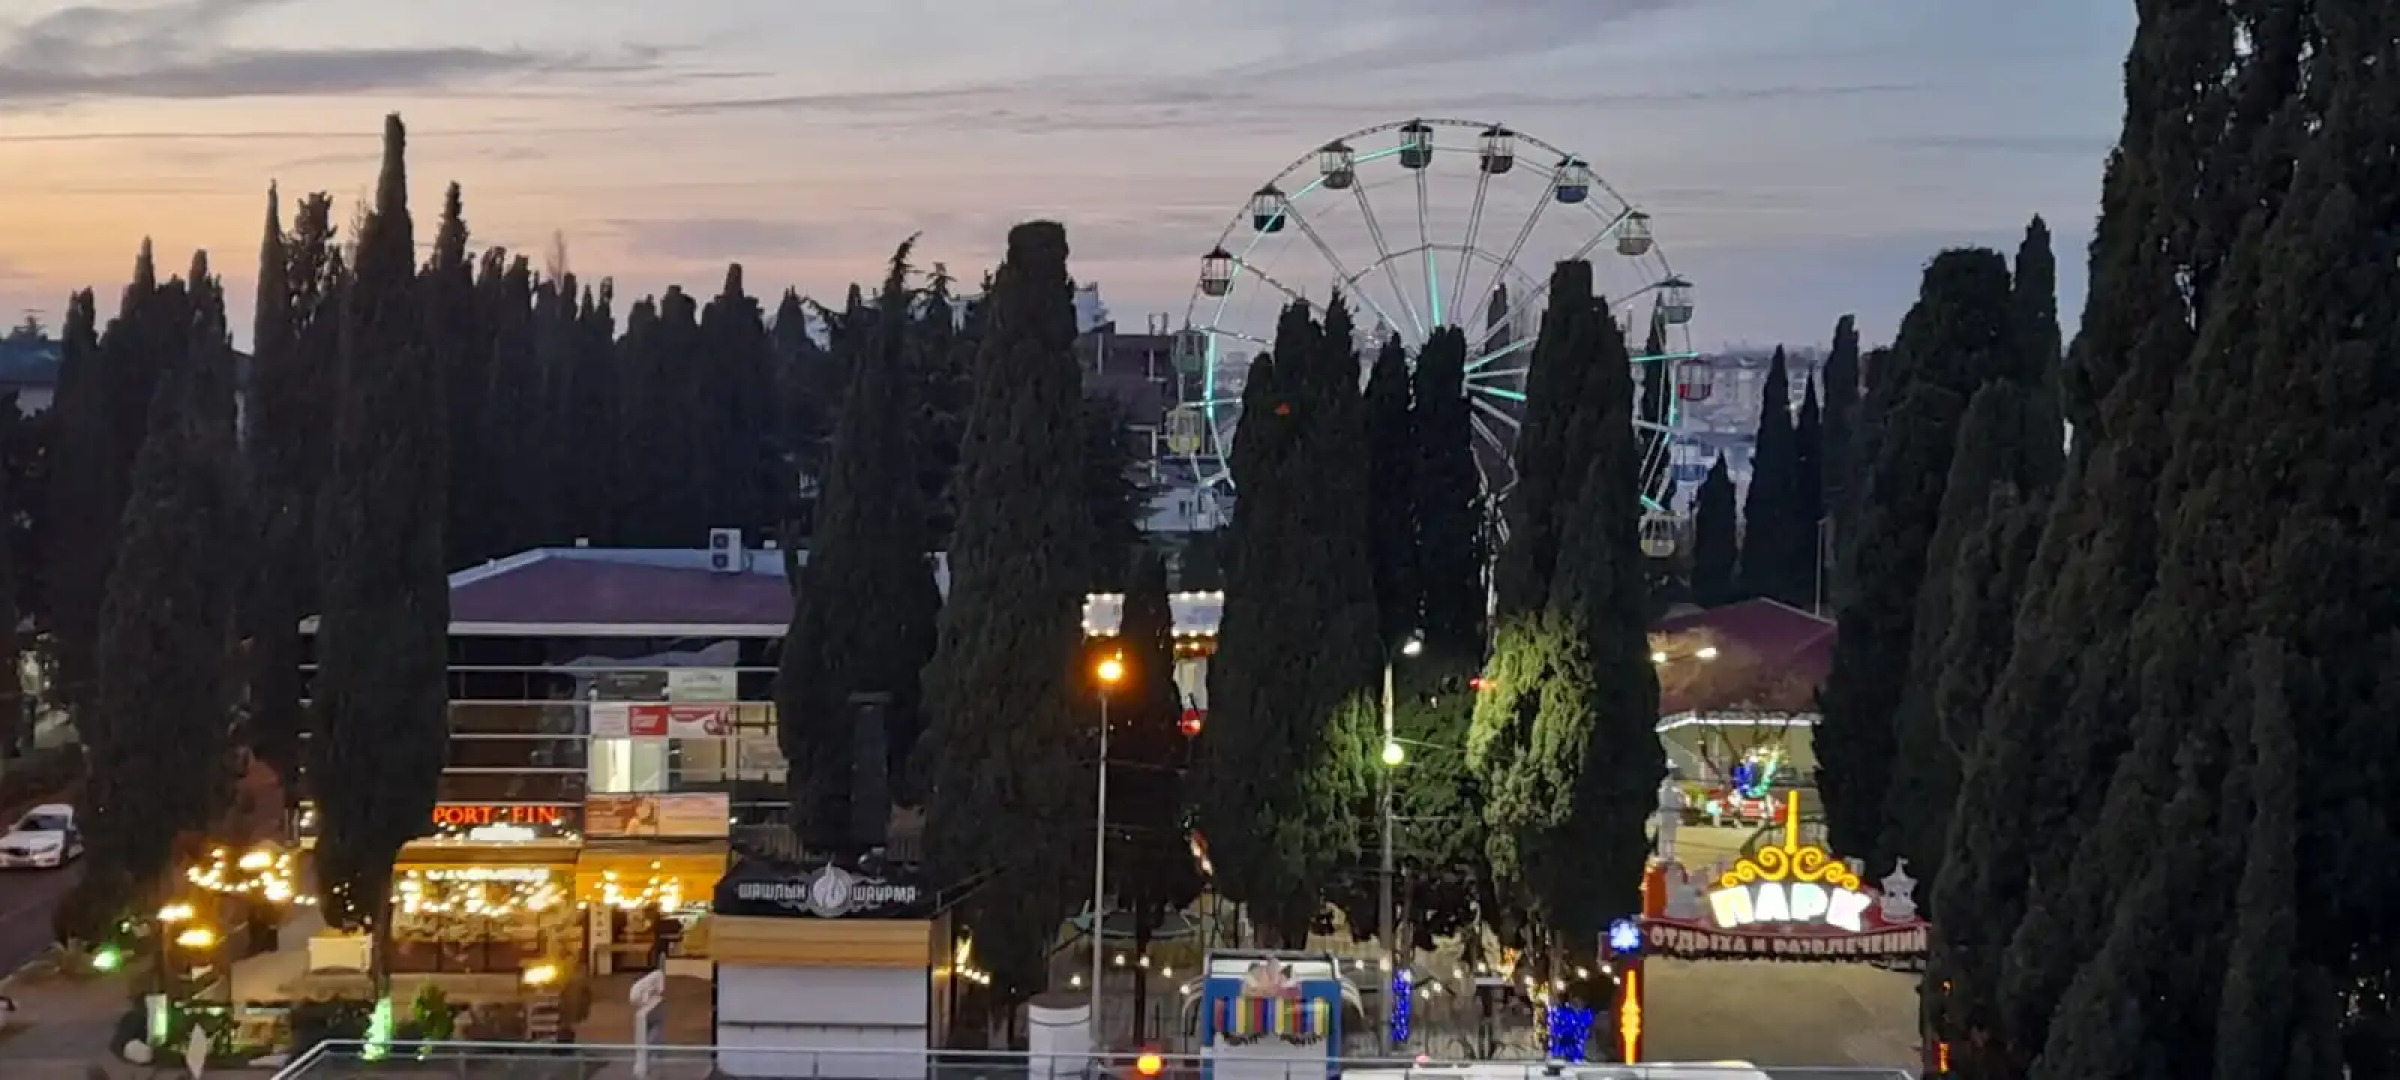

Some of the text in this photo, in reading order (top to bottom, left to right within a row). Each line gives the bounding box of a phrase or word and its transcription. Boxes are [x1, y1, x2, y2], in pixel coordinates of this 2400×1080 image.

[432, 804, 493, 824] PORT
[852, 884, 917, 904] ШАУРМА
[1709, 881, 1873, 932] ПАРК
[1650, 925, 1747, 953] ОТДЫХА
[1773, 925, 1928, 955] РАЗВЛЕЧЕНИЙ
